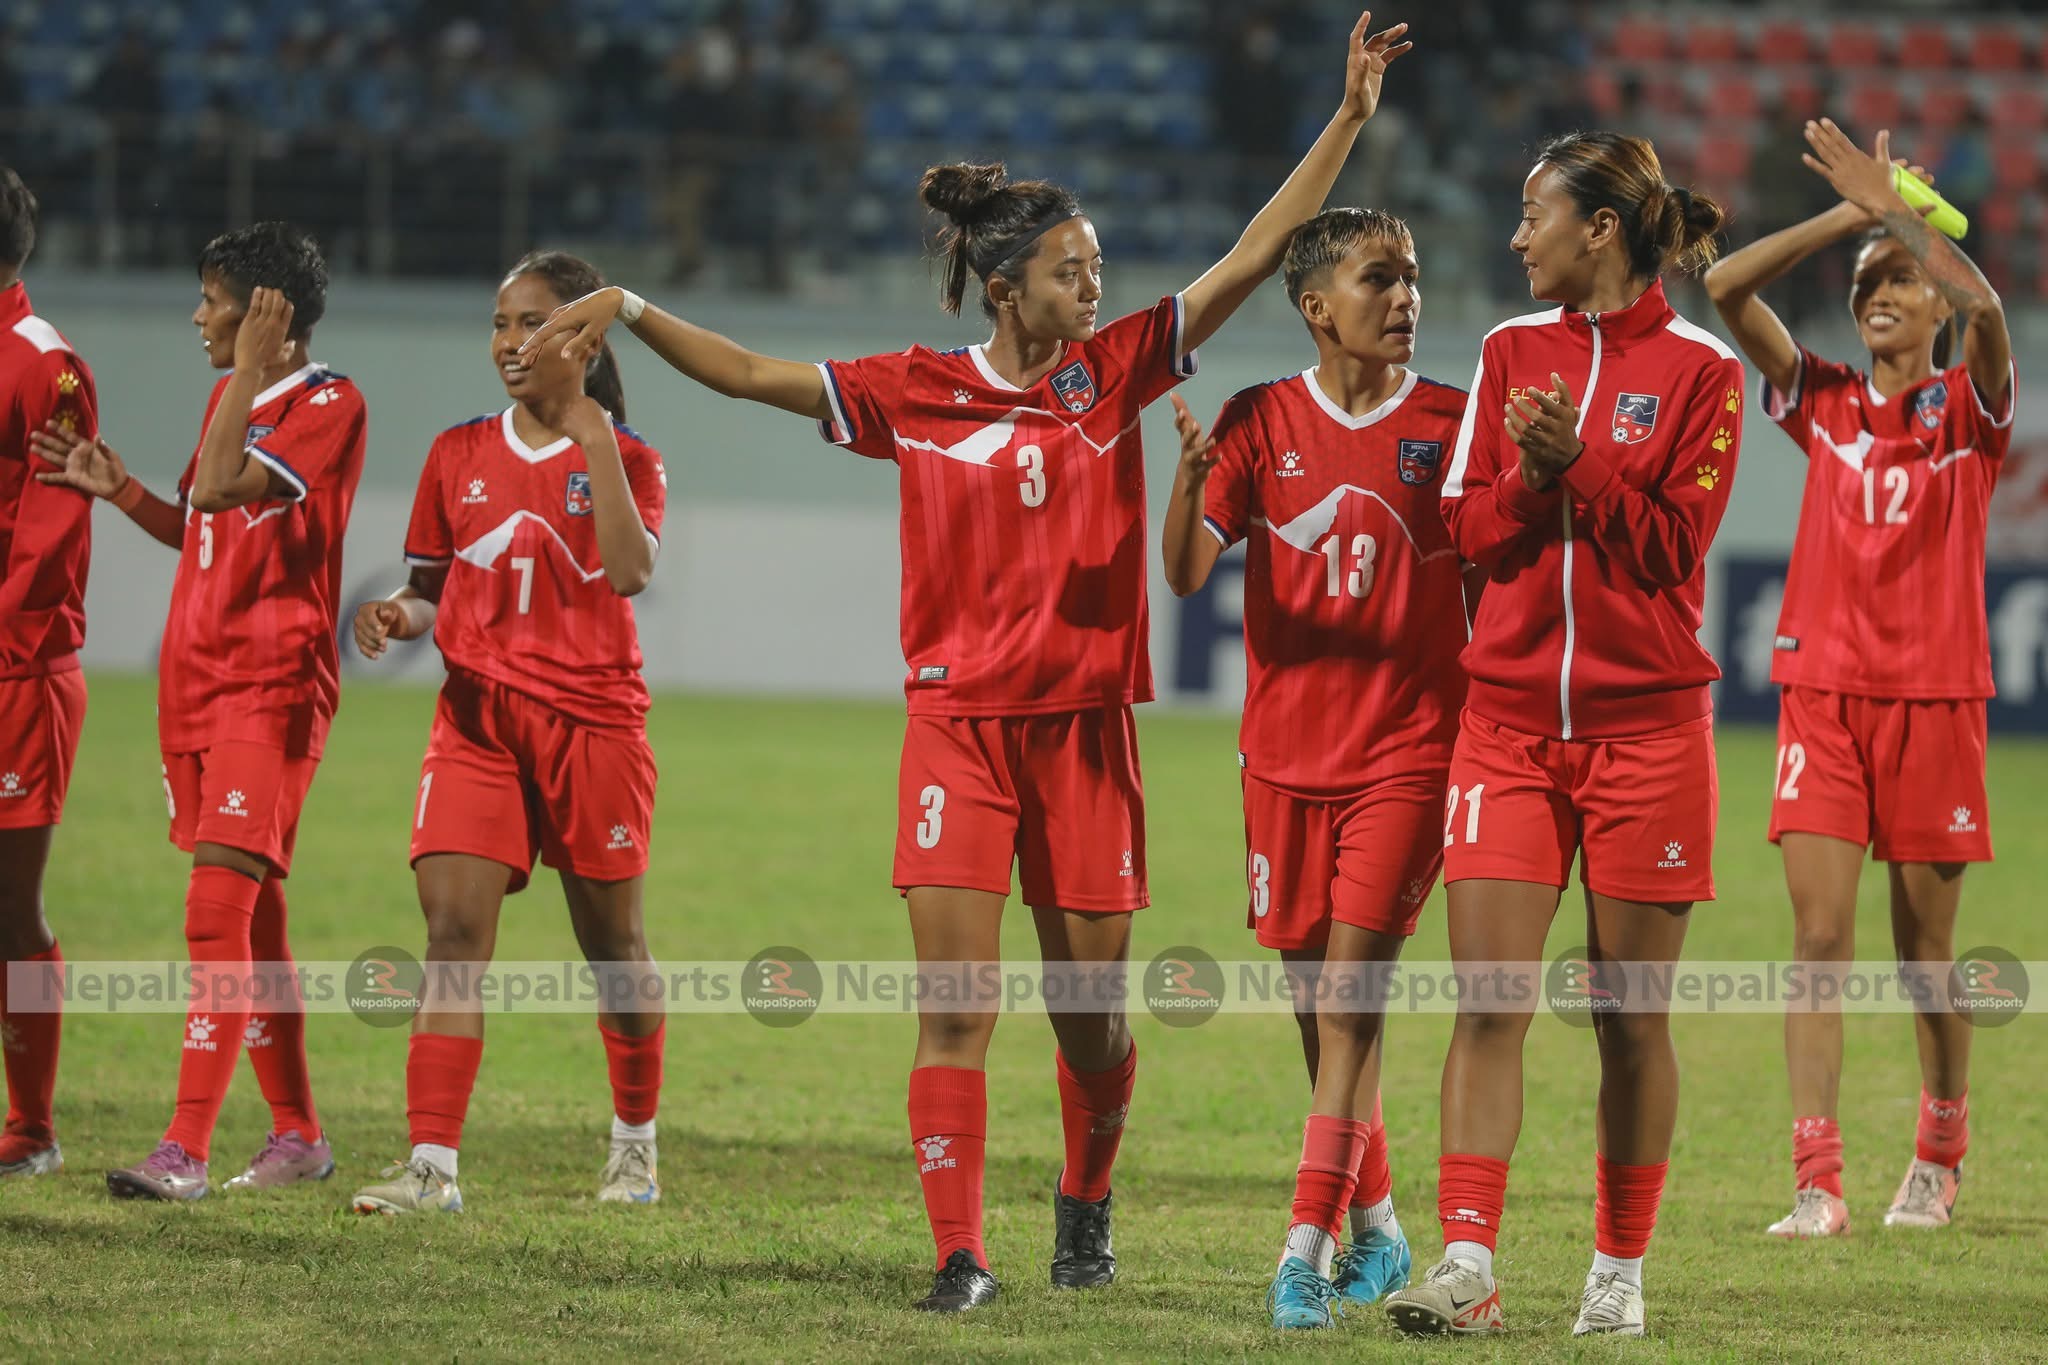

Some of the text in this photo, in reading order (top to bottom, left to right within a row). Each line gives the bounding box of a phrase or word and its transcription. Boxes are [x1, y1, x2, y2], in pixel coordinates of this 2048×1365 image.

[1628, 396, 1648, 405] NEPAL
[462, 495, 489, 504] KELME
[1016, 444, 1047, 508] 3
[1276, 469, 1305, 477] KELME
[1863, 466, 1910, 525] 12
[199, 512, 214, 570] 5
[1321, 533, 1377, 599] 13
[511, 557, 535, 615] 7
[916, 784, 946, 849] 3
[1444, 783, 1486, 849] 21
[1657, 860, 1688, 868] KELME
[921, 1158, 957, 1174] KELME
